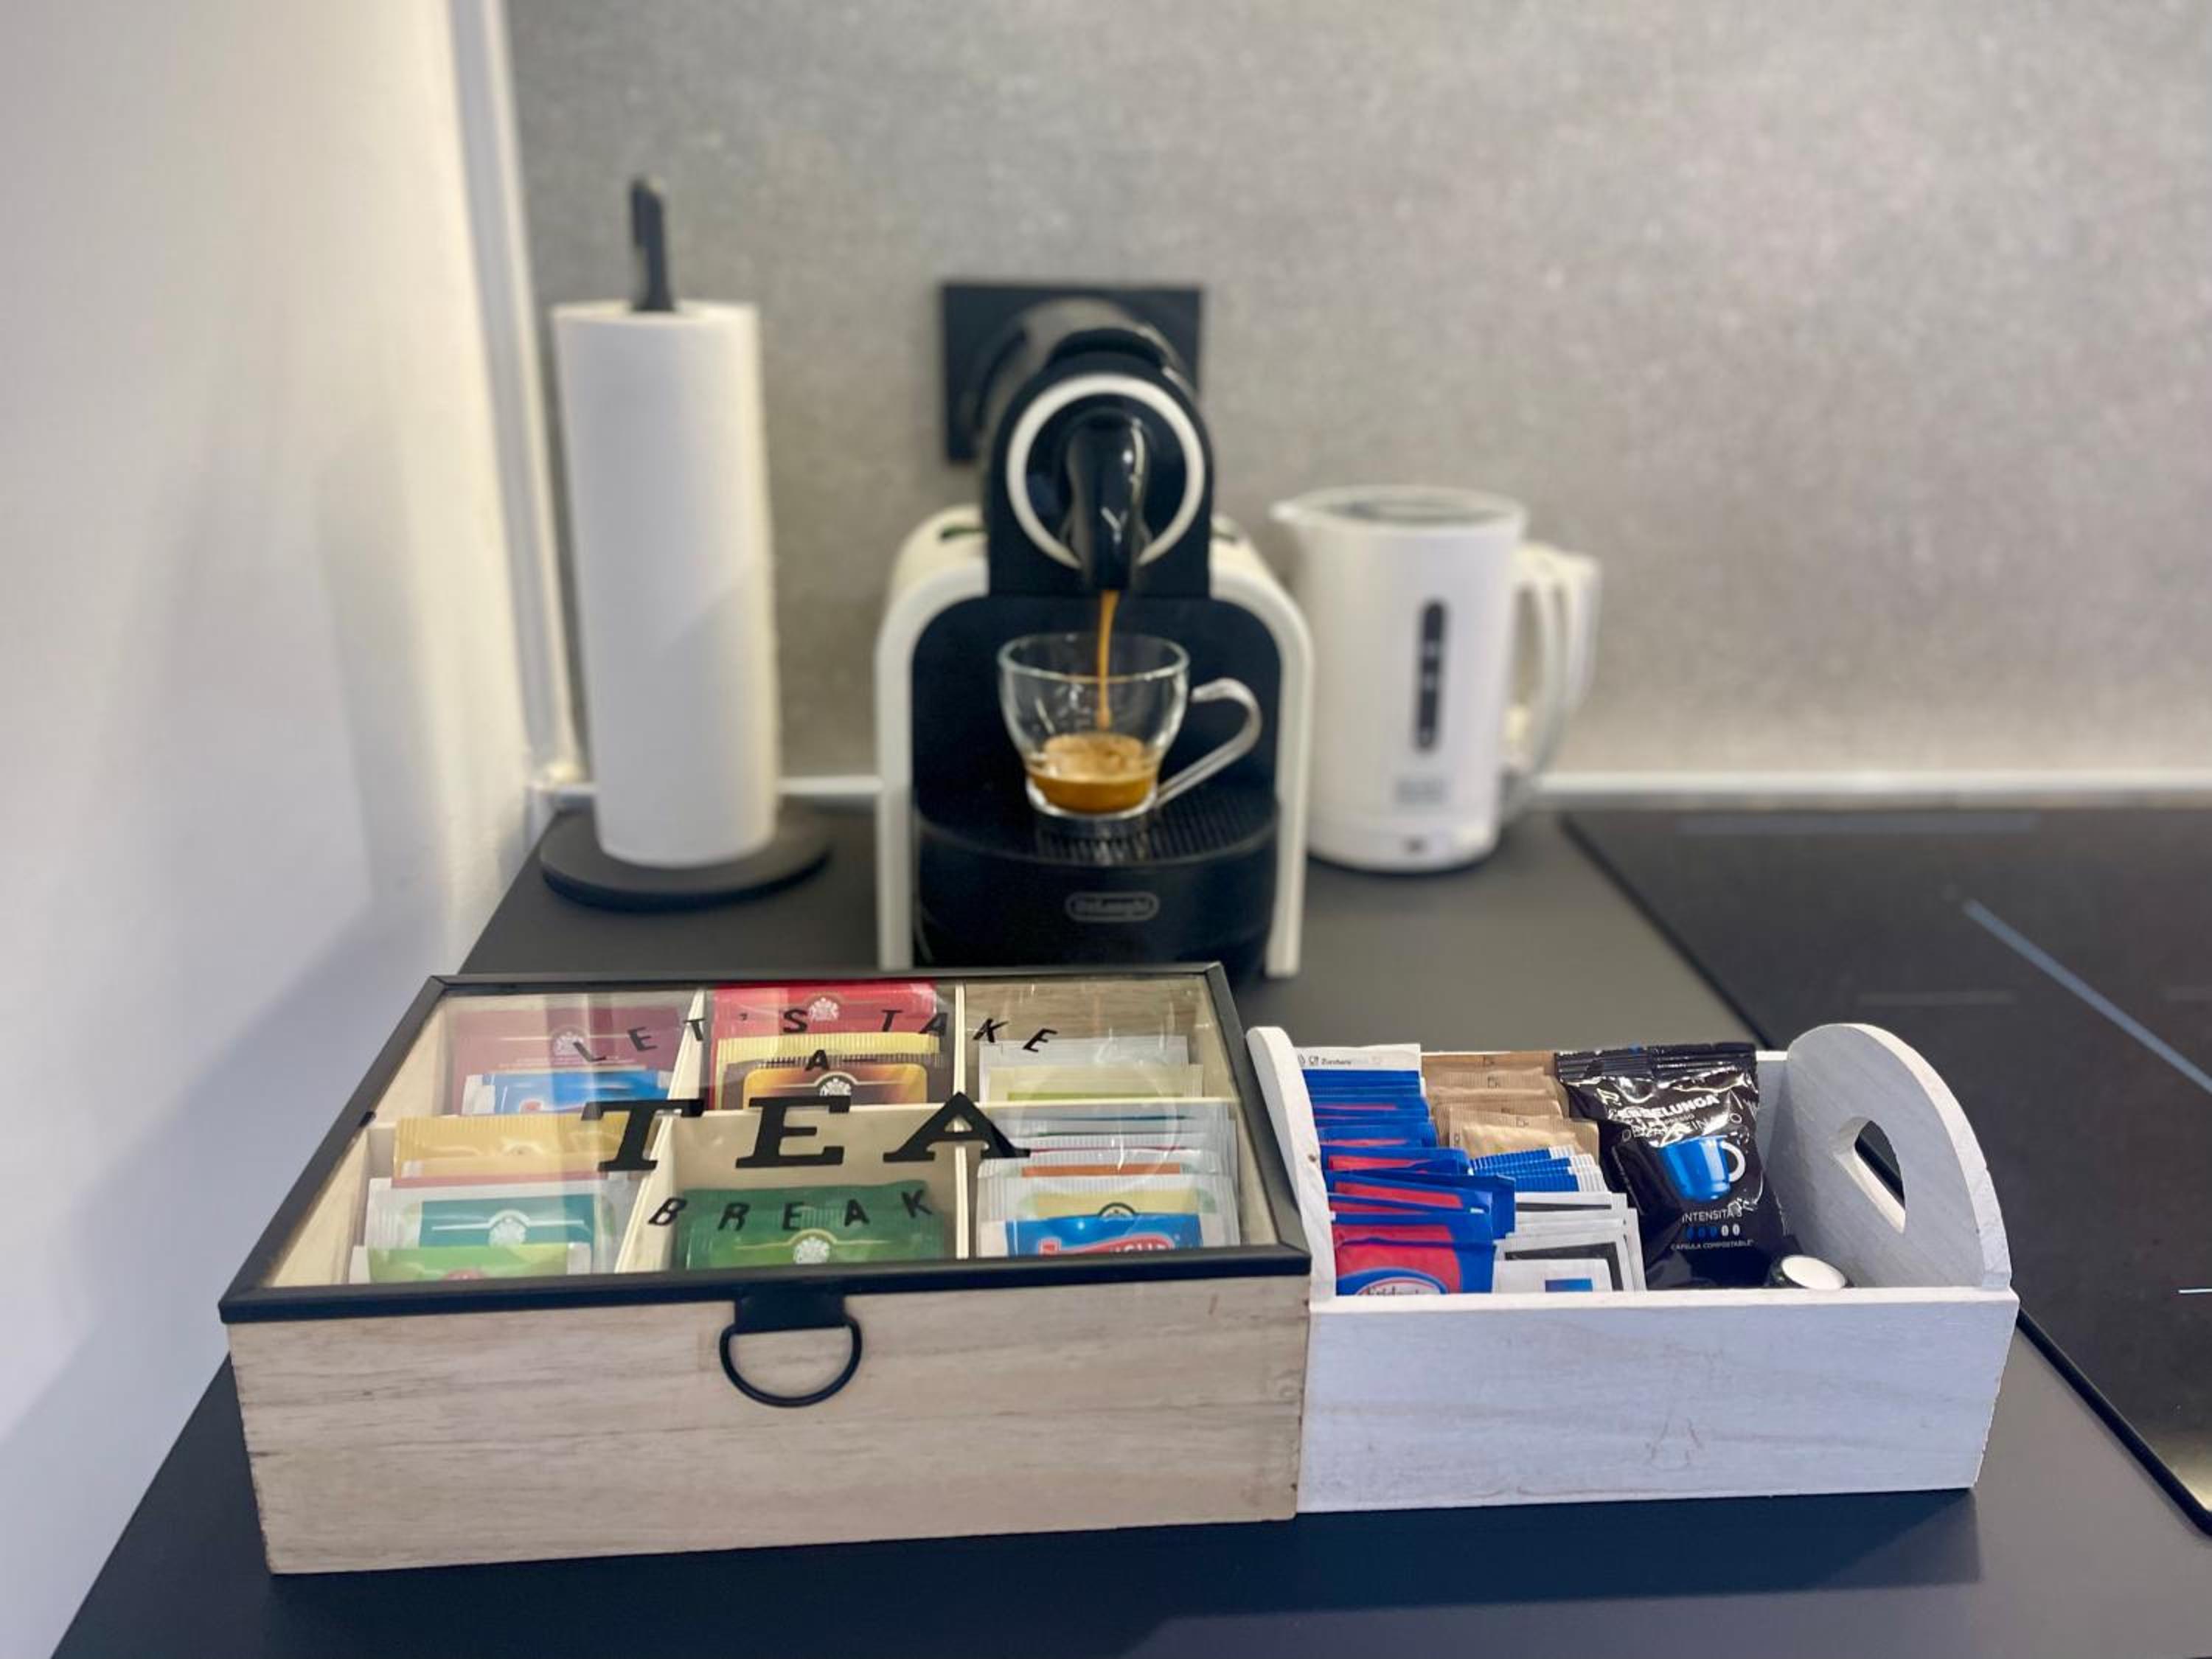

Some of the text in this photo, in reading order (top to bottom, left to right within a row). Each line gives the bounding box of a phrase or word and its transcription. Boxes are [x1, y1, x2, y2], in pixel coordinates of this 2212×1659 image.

[880, 1009, 1058, 1053] TAKE
[804, 1048, 831, 1072] A
[580, 1091, 1031, 1172] TEA
[648, 1189, 933, 1231] BREAK
